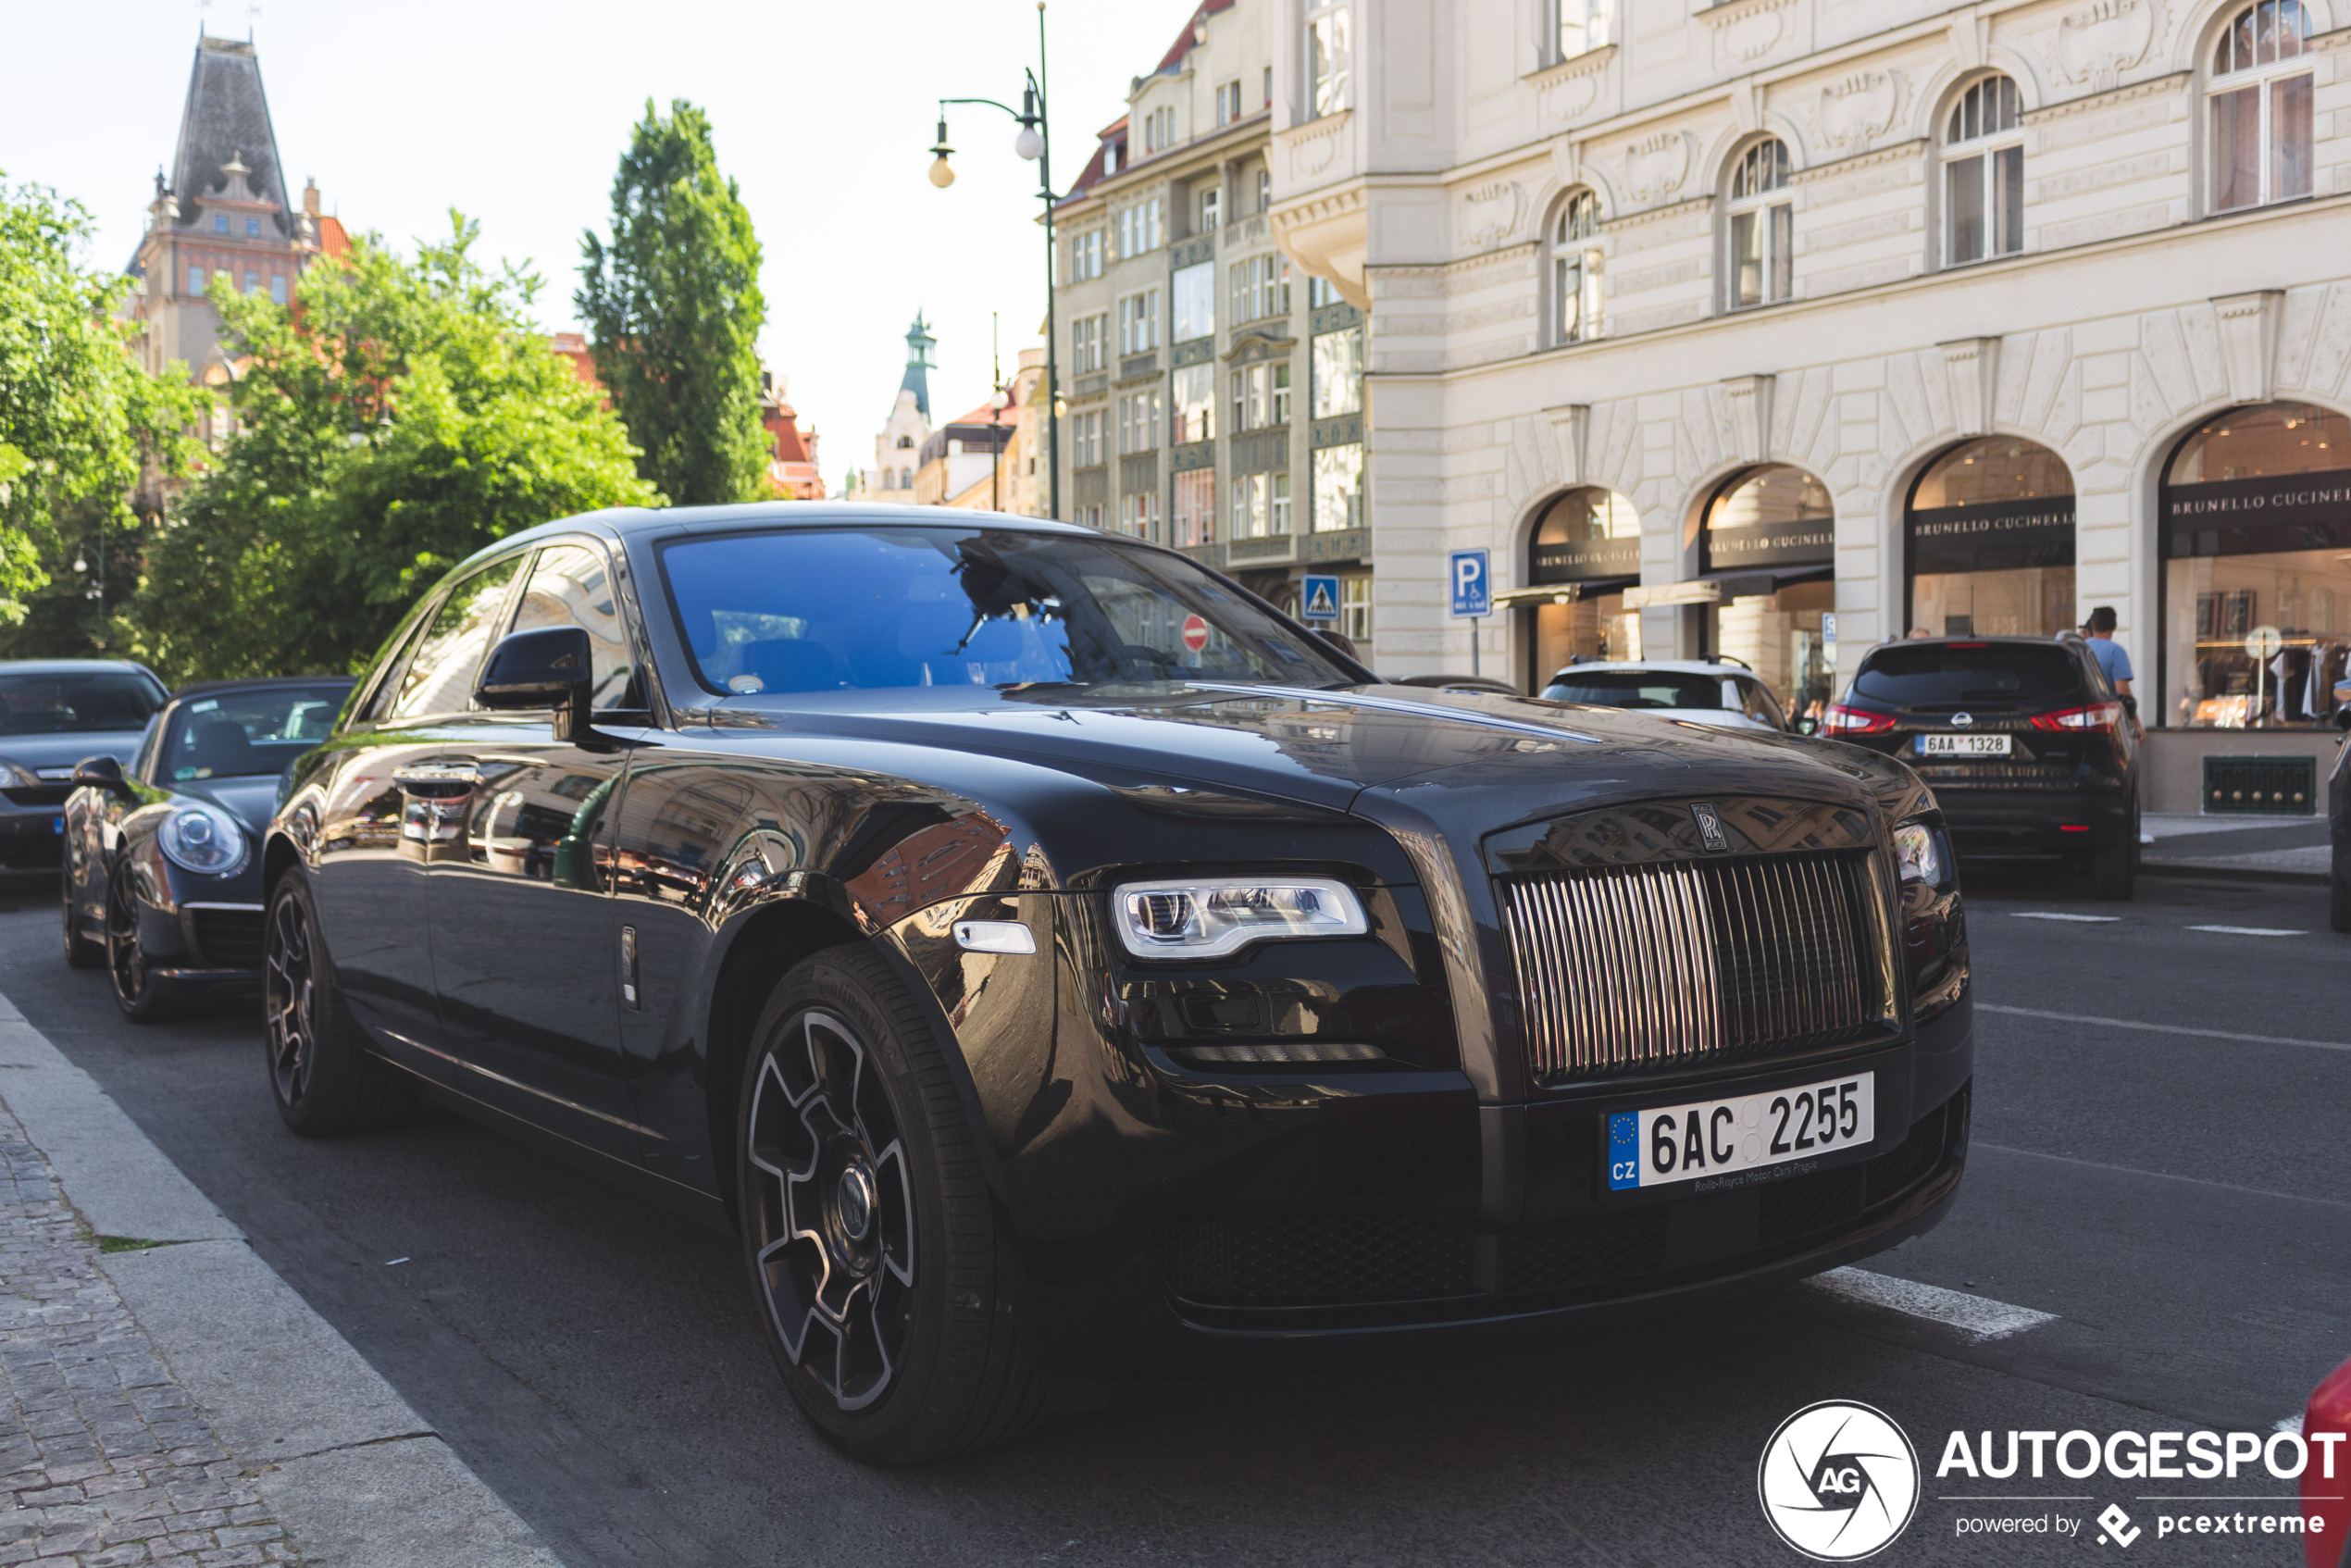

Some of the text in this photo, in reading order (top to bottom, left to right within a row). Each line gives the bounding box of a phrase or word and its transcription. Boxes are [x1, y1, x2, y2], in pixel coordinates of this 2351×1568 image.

[2172, 495, 2265, 516] BRUNELLO
[1915, 518, 1990, 537] BRUNELLO
[1457, 557, 1481, 598] P
[1928, 737, 2004, 752] 6AA 1328
[1651, 1081, 1859, 1175] 6AC 2255
[1612, 1161, 1636, 1181] CZ
[1695, 1160, 1818, 1192] Rolls-Royce Motor Cars Prague
